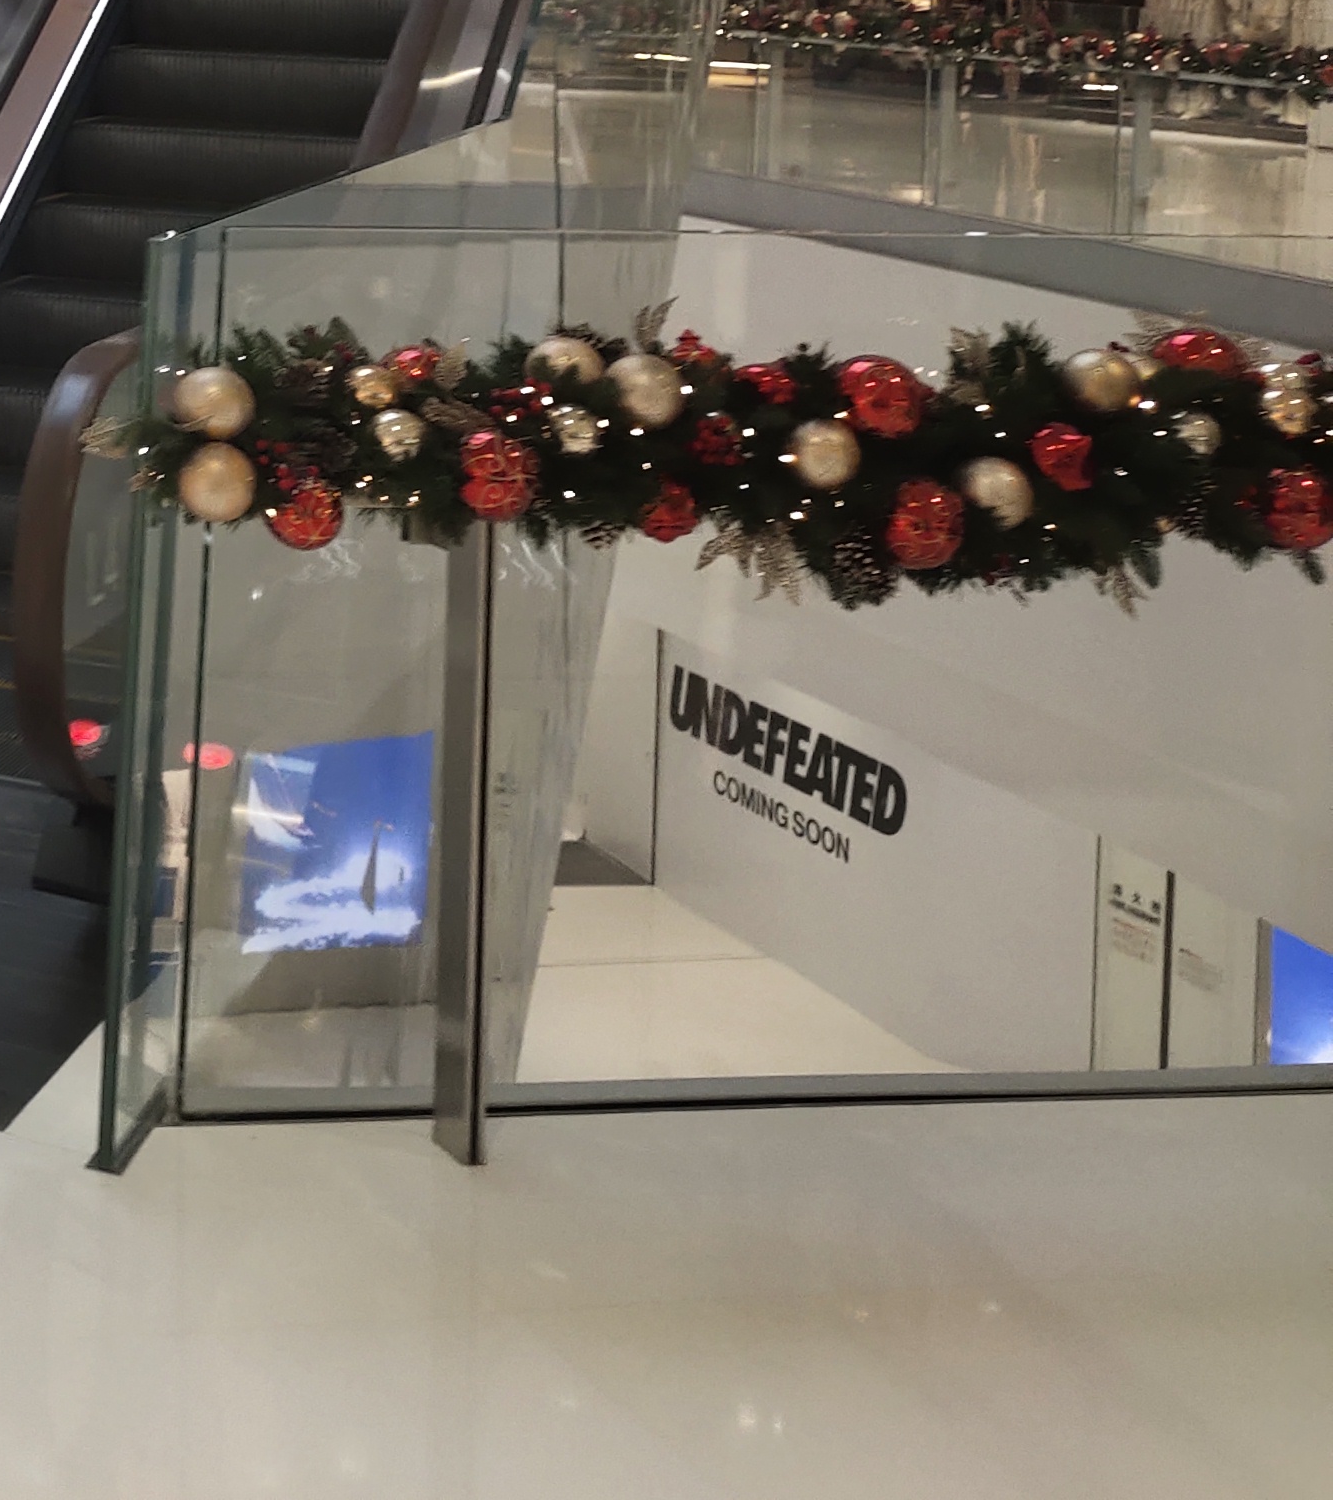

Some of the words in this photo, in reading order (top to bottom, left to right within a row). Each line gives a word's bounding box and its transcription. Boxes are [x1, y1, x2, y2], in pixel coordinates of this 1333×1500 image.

[670, 664, 907, 836] UNDEFEATED
[713, 770, 789, 830] COMING
[792, 810, 850, 864] SOON
